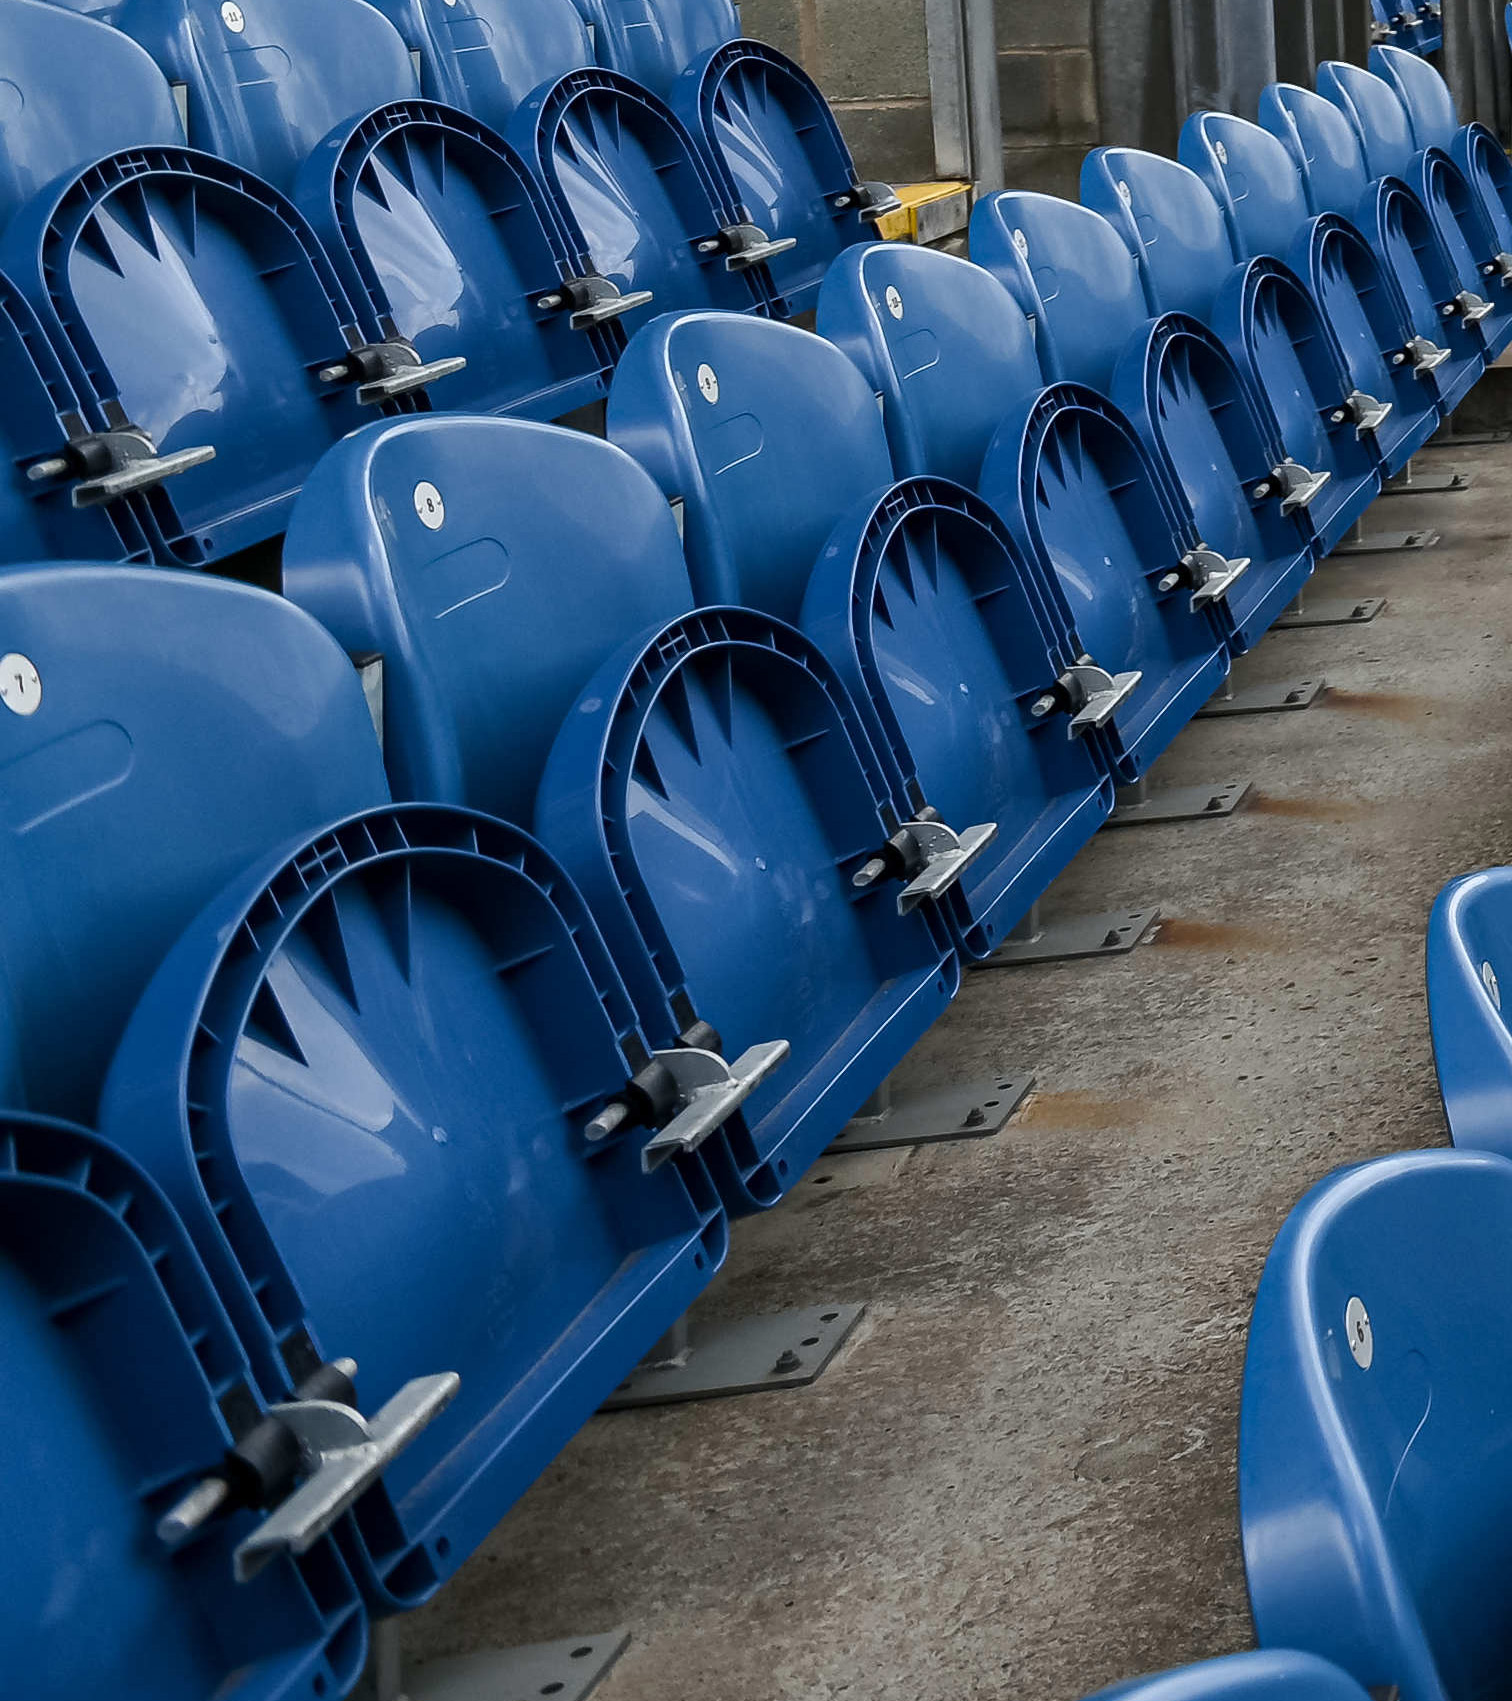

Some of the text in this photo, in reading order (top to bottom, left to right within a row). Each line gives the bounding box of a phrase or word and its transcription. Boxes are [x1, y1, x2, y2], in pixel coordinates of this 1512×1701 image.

[228, 11, 238, 23] 11
[426, 497, 435, 513] 8
[1356, 1321, 1364, 1344] 6
